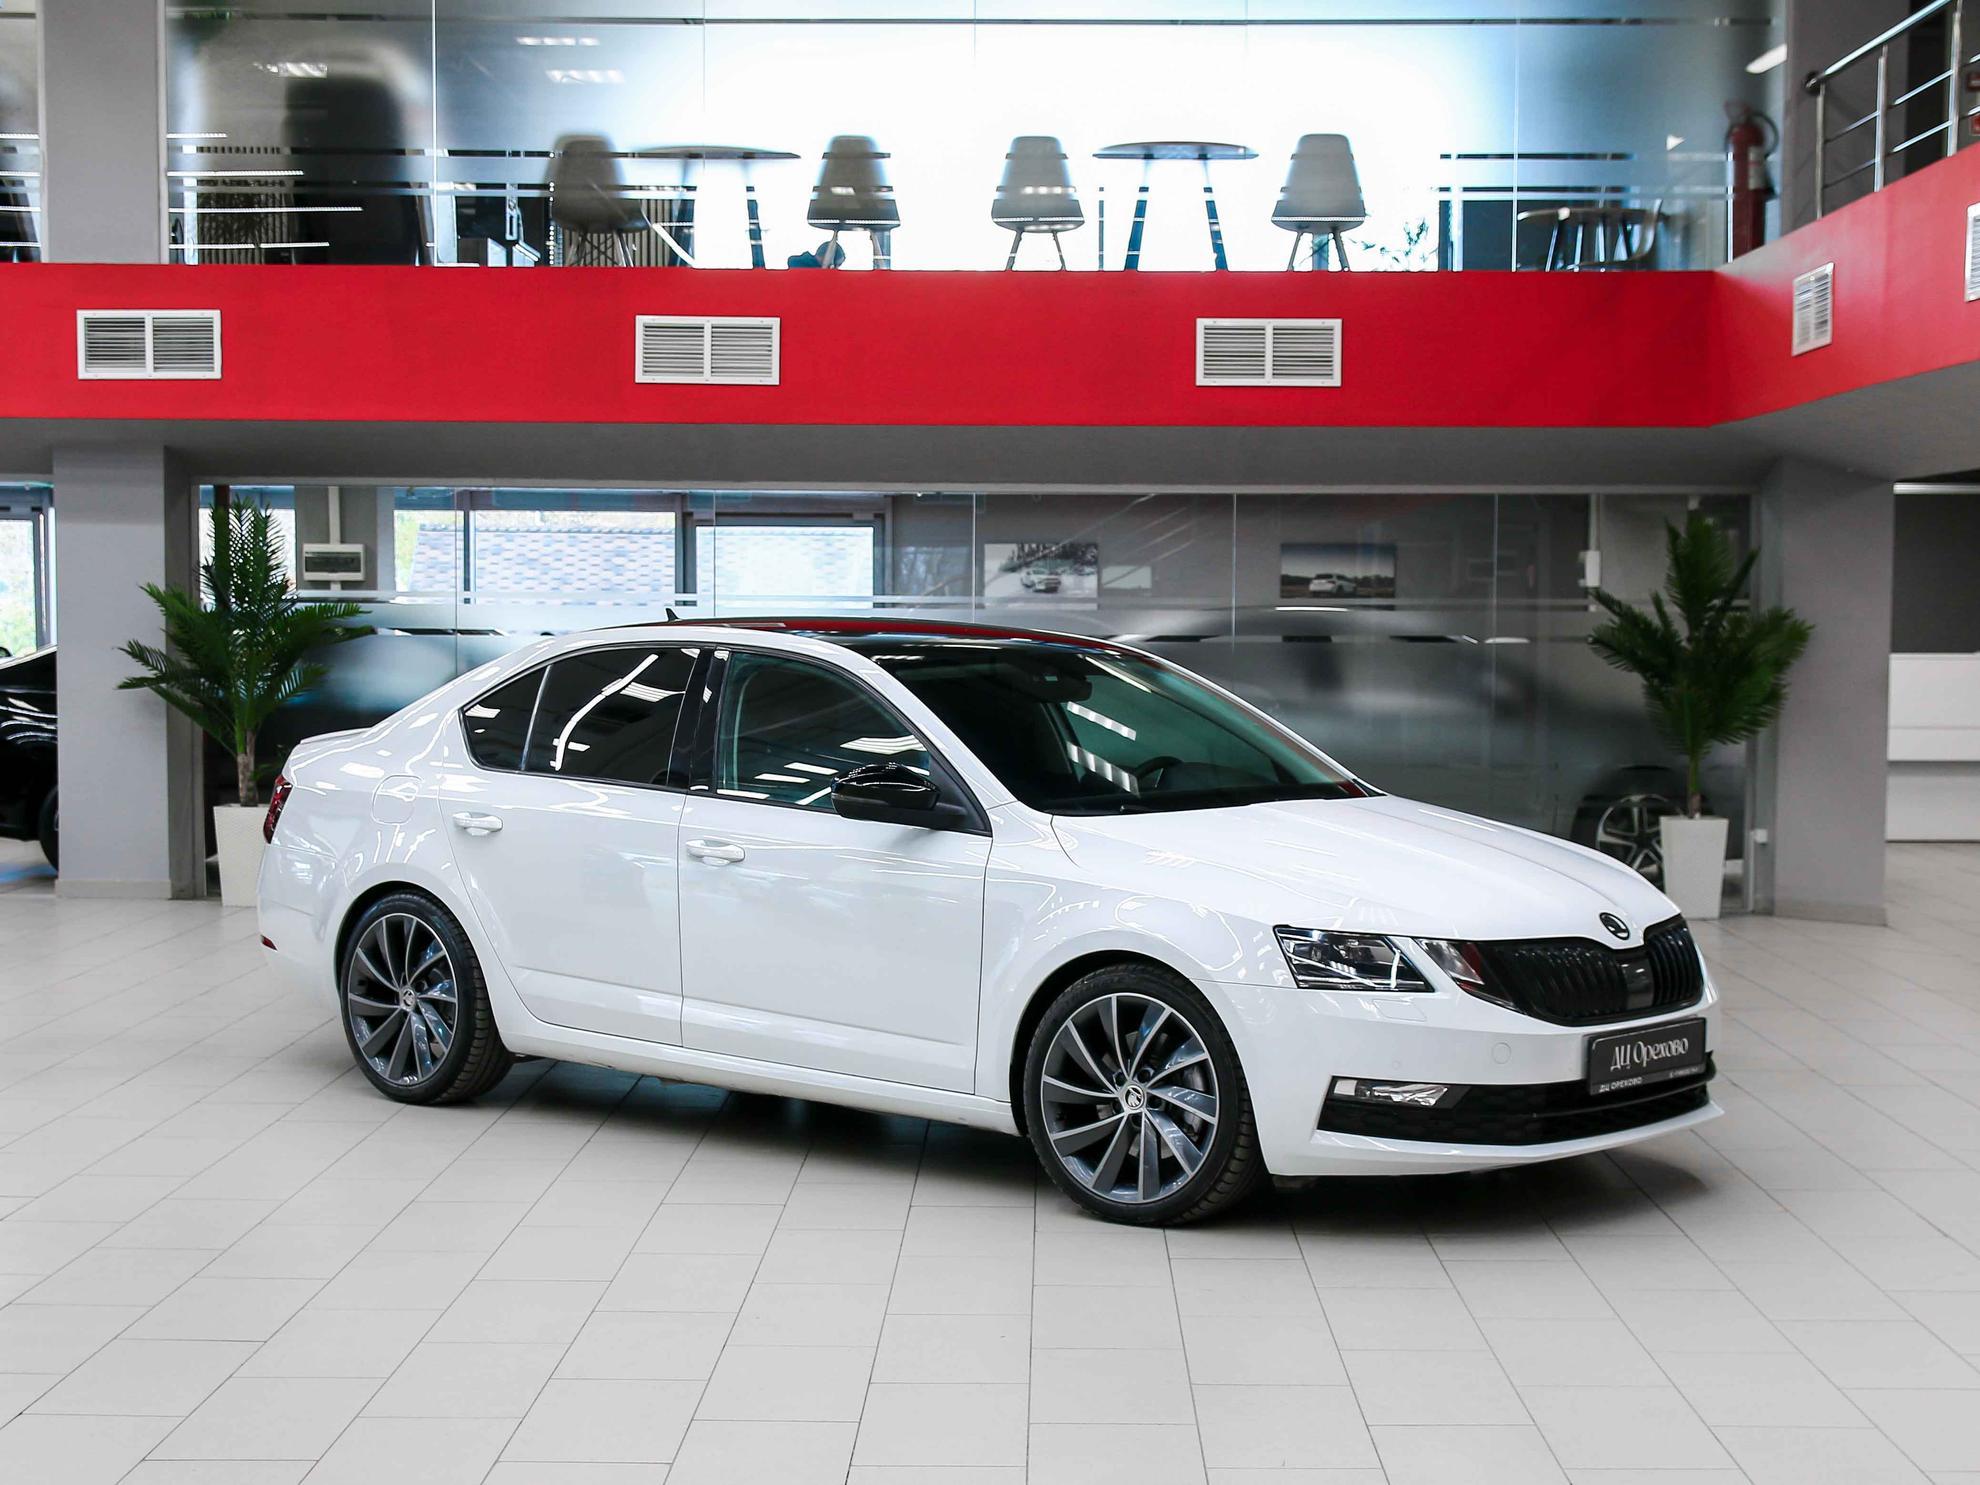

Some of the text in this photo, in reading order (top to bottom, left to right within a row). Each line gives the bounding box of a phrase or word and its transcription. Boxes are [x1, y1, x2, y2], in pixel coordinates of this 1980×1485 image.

[1610, 1038, 1689, 1072] ДЦ Орехово
[1611, 1077, 1643, 1090] ОРЕХОВО
